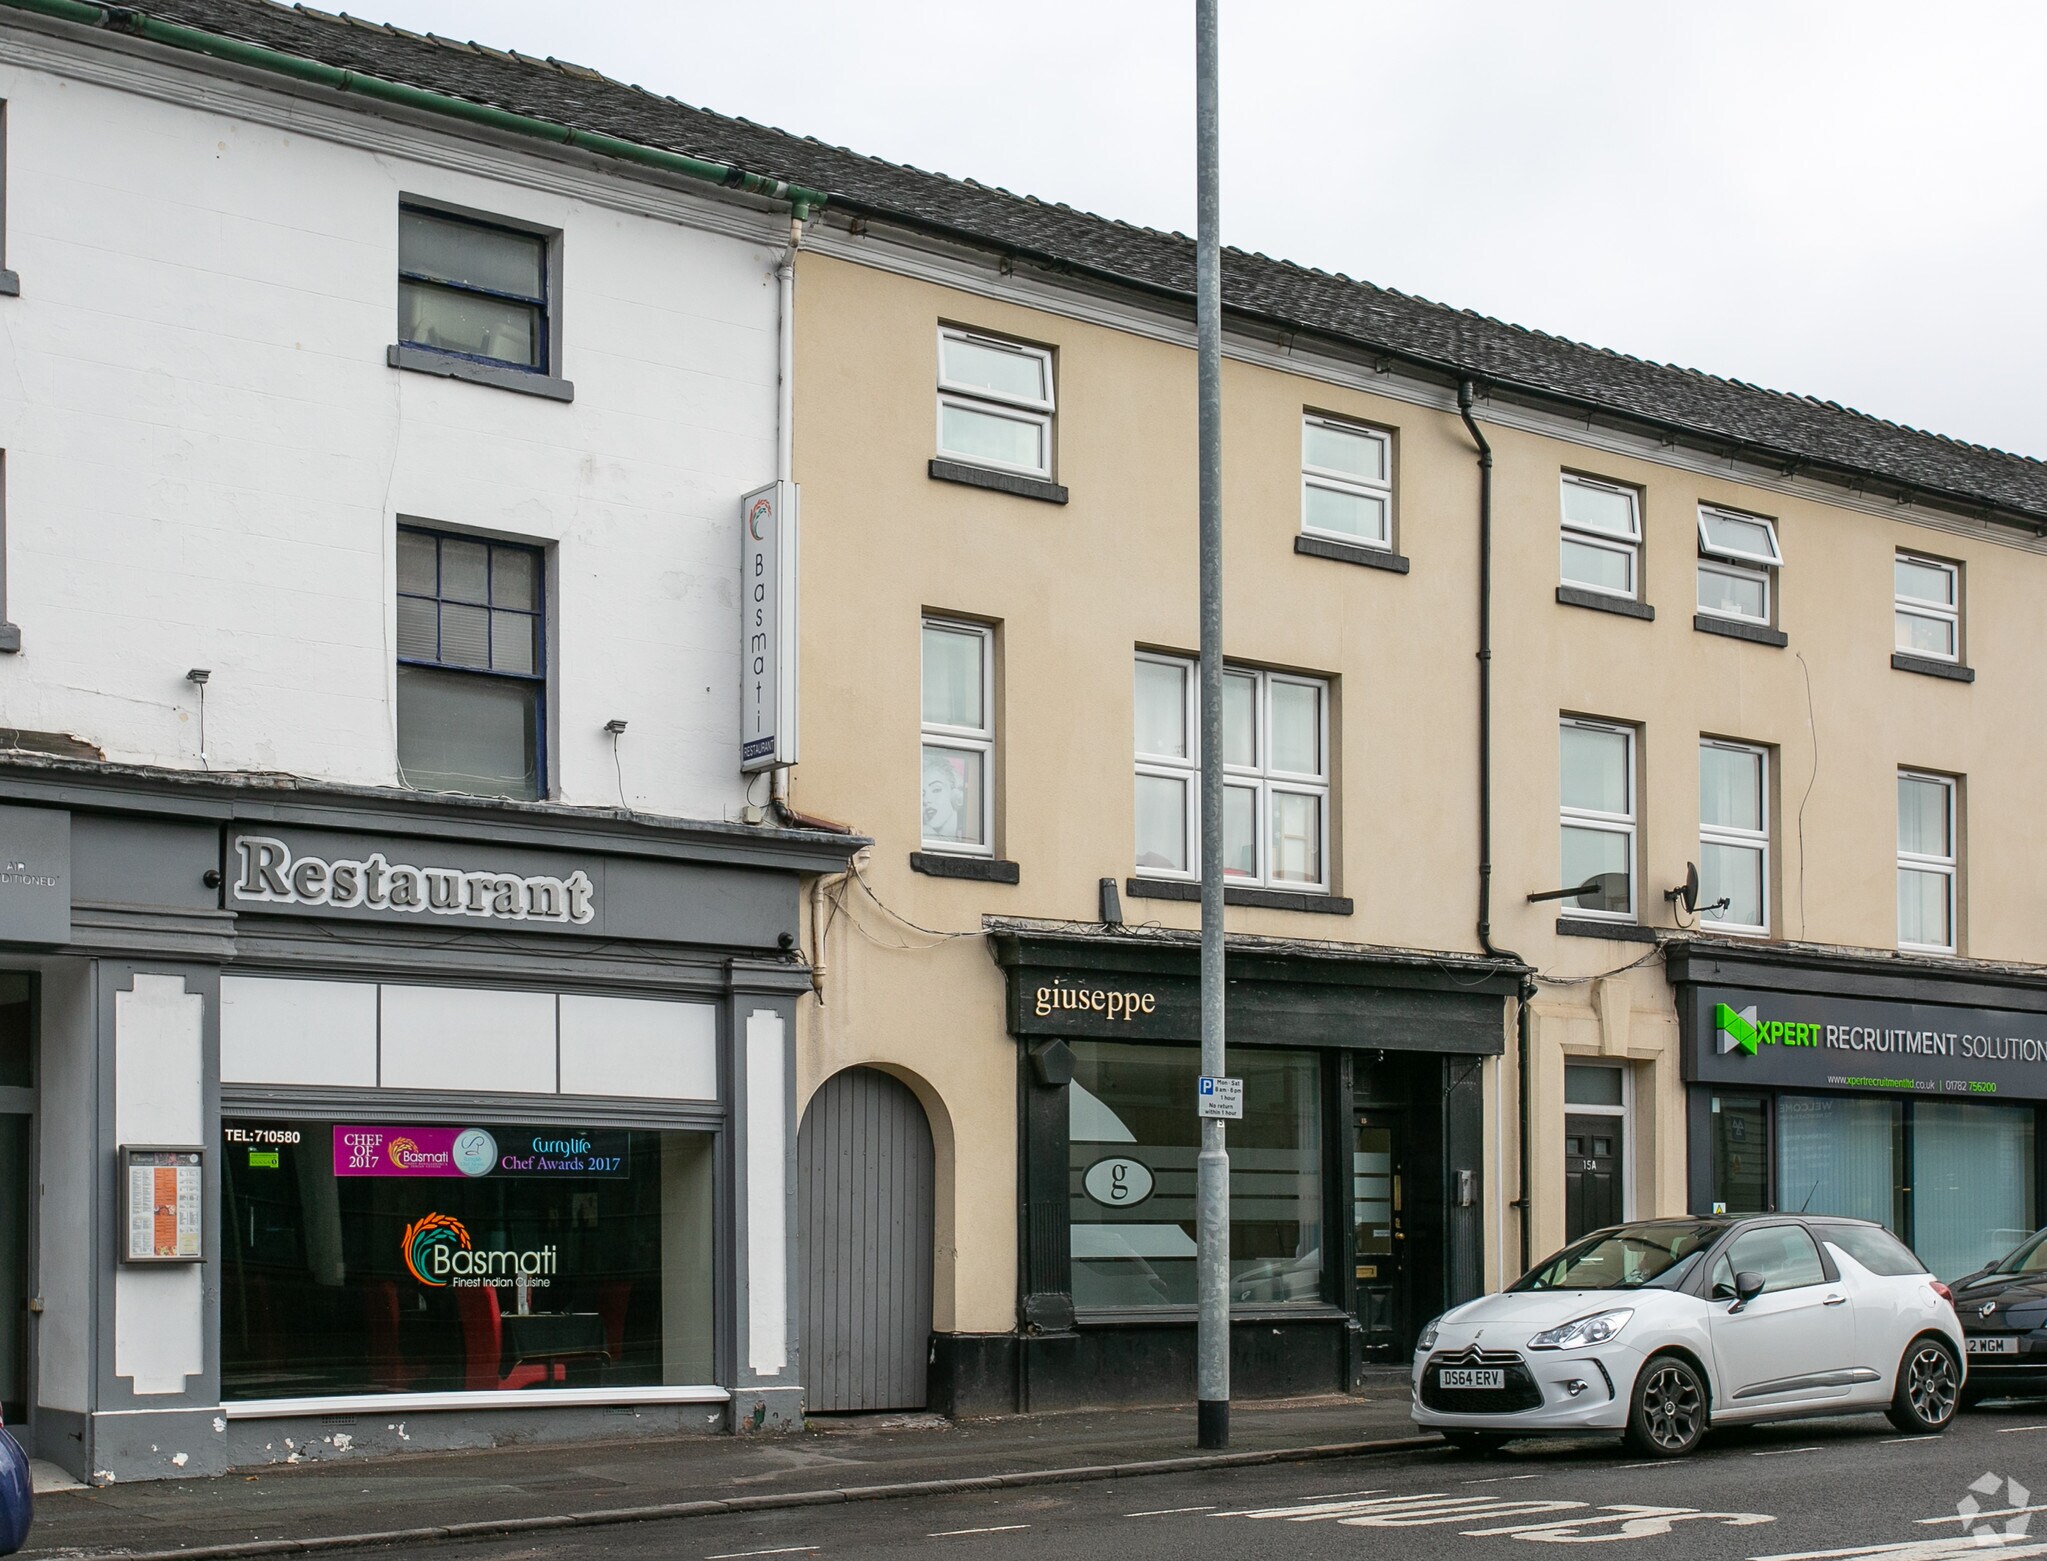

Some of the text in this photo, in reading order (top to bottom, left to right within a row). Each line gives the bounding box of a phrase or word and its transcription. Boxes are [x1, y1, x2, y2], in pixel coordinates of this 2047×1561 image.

[751, 553, 767, 733] Basmati
[6, 861, 26, 871] AIR
[0, 872, 56, 887] DITIONED
[237, 837, 591, 921] Restaurant
[1035, 978, 1156, 1021] giuseppe
[1756, 1020, 1821, 1047] XPERT
[1826, 1025, 1957, 1056] RECRUITMENT
[1203, 1080, 1212, 1093] P
[1945, 1079, 1967, 1092] 01782
[1968, 1080, 1997, 1093] 756200
[344, 1134, 383, 1146] CHEF
[353, 1145, 374, 1157] OF
[403, 1151, 449, 1163] Basmati
[349, 1156, 379, 1168] 2017
[502, 1155, 535, 1170] Chef
[537, 1156, 584, 1170] Awards
[588, 1157, 621, 1171] 2017
[1583, 1160, 1597, 1170] 15A
[434, 1244, 556, 1274] Basmati
[452, 1277, 550, 1287] Finest Indian Cuisine
[1980, 1340, 2004, 1352] WGM
[1444, 1371, 1499, 1385] DS64 ERV
